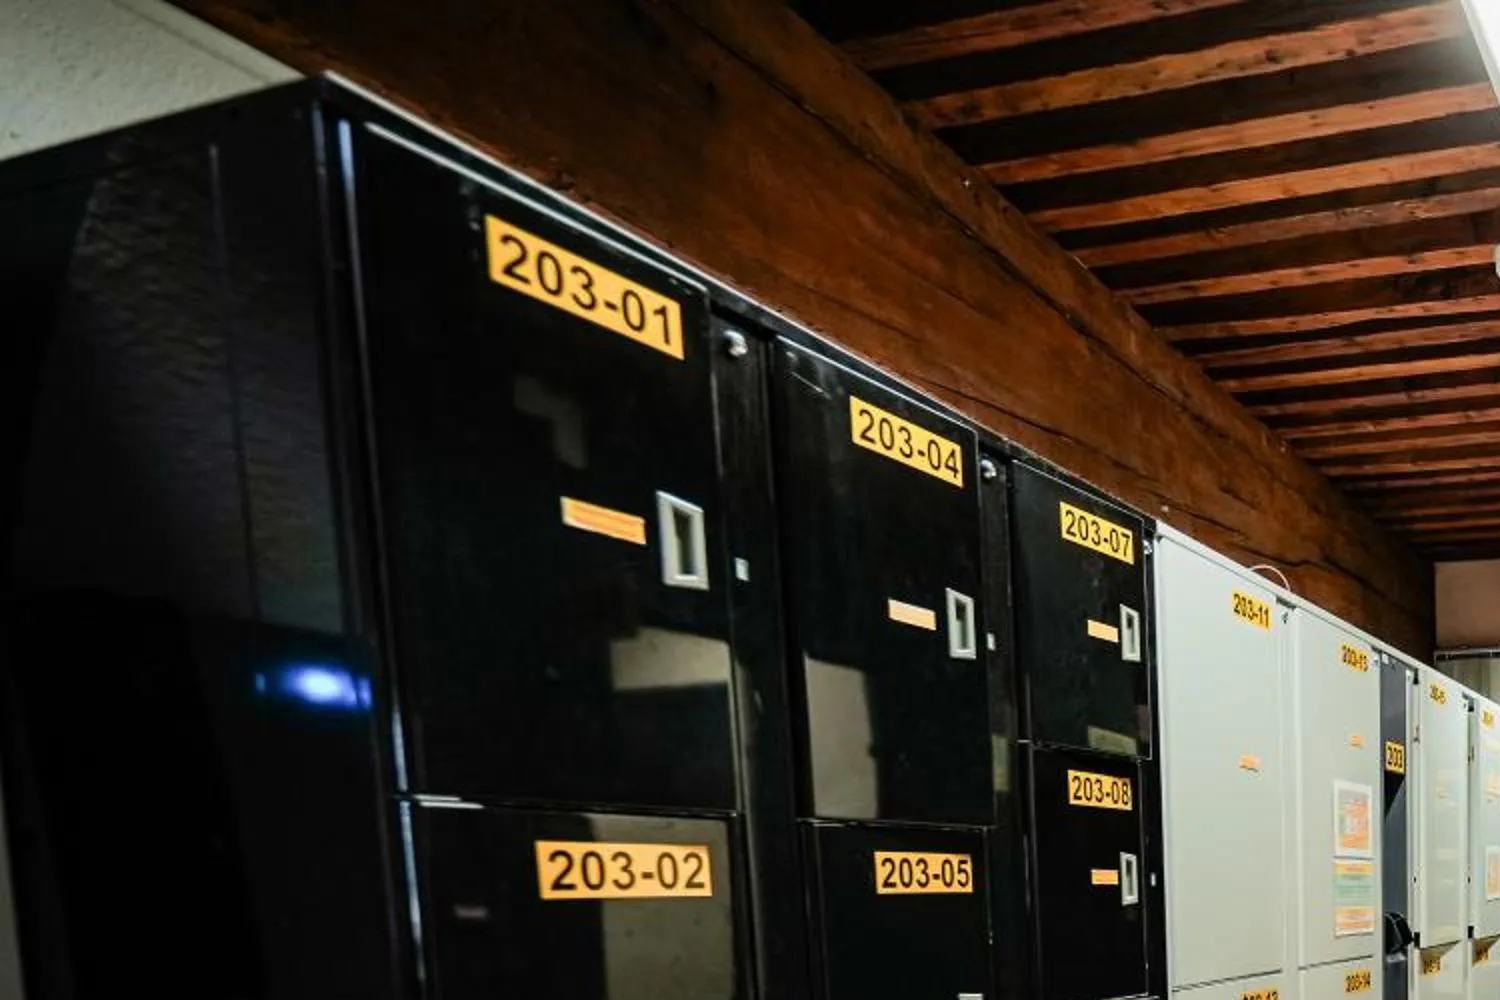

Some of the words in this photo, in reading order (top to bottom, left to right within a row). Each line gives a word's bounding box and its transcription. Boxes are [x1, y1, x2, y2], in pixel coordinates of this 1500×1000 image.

[500, 234, 673, 346] 203-01
[859, 408, 959, 480] 203-04
[1065, 510, 1131, 557] 203-07
[1233, 593, 1269, 629] 203-11
[1071, 776, 1130, 806] 203-08
[548, 849, 706, 891] 203-02
[881, 858, 971, 890] 203-05
